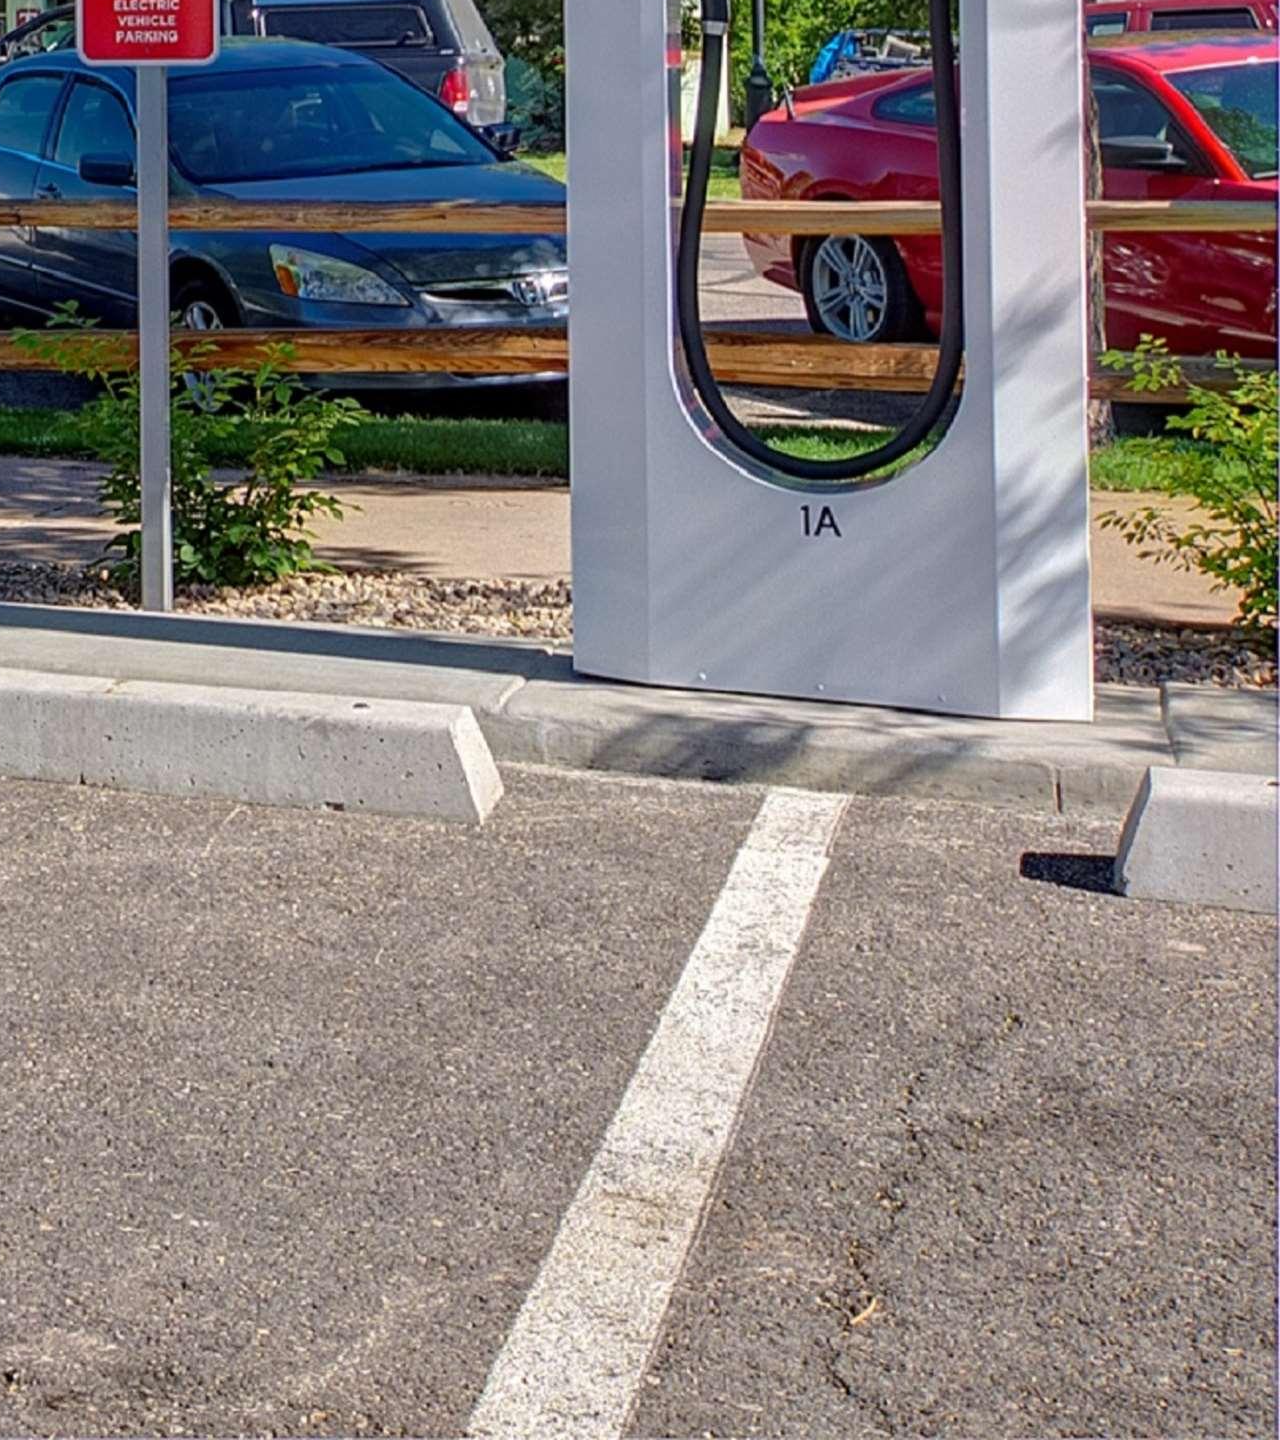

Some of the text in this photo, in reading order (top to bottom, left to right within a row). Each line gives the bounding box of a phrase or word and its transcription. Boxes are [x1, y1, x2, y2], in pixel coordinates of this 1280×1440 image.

[117, 14, 176, 27] VEHICLE
[115, 30, 179, 43] PARKING
[800, 505, 842, 537] 1A
